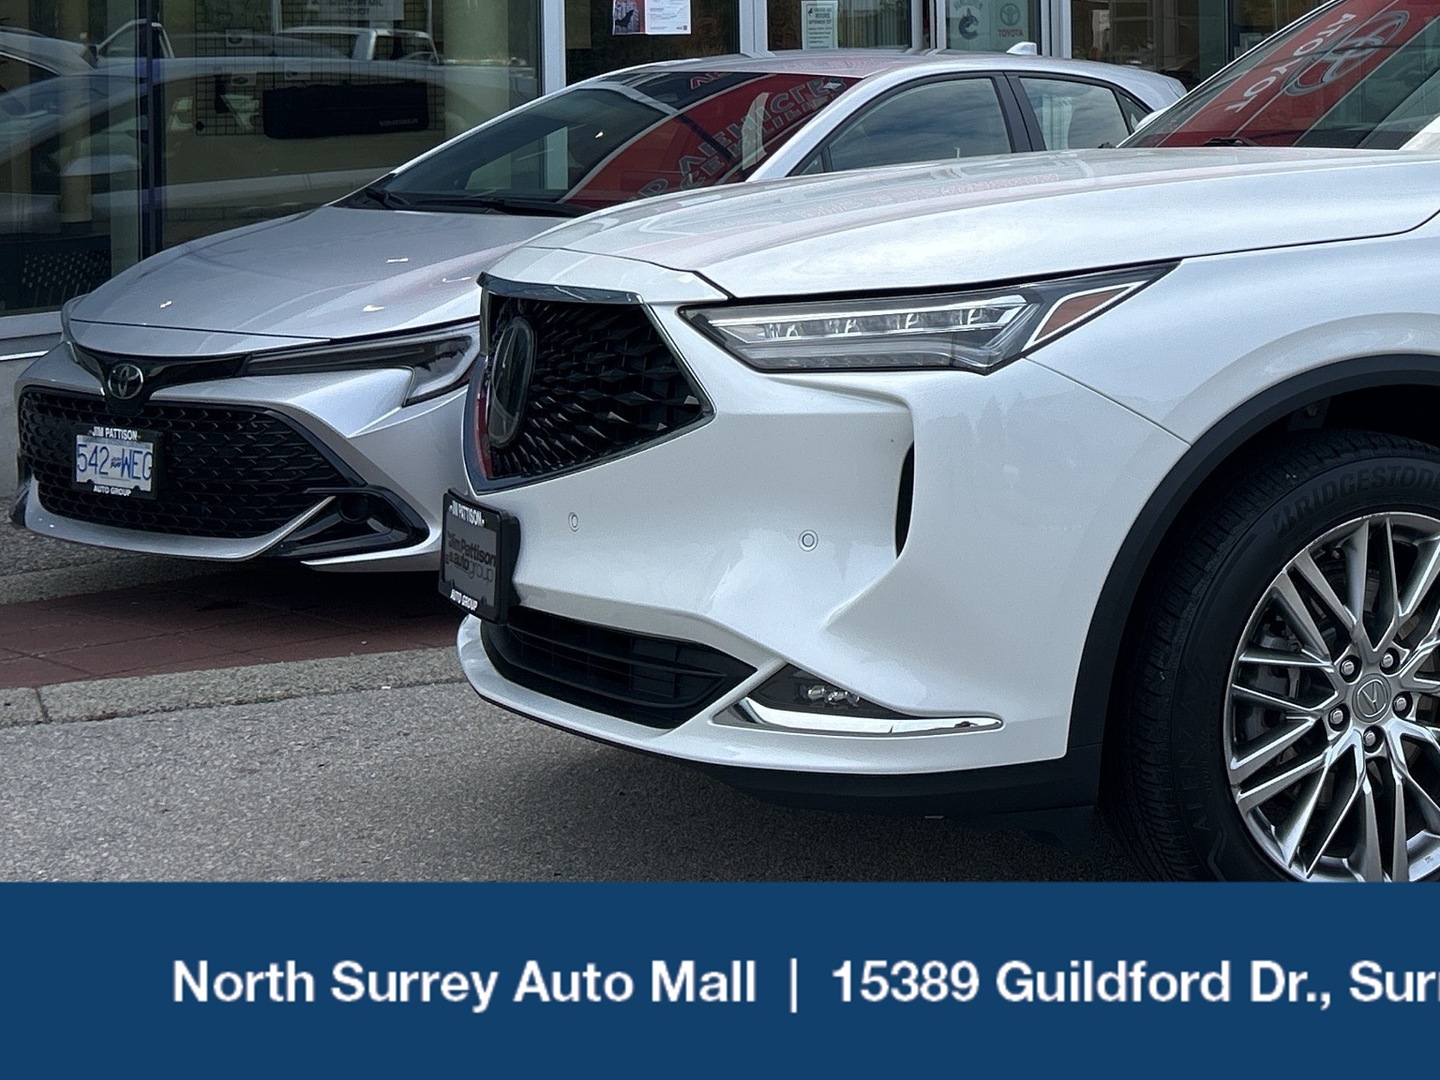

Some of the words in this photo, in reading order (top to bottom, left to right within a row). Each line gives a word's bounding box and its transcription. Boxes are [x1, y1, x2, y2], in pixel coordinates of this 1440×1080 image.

[92, 426, 104, 437] JIM
[105, 427, 138, 440] PATTISON
[77, 443, 110, 475] 542
[93, 485, 110, 494] AUTO
[110, 487, 132, 497] GROUP
